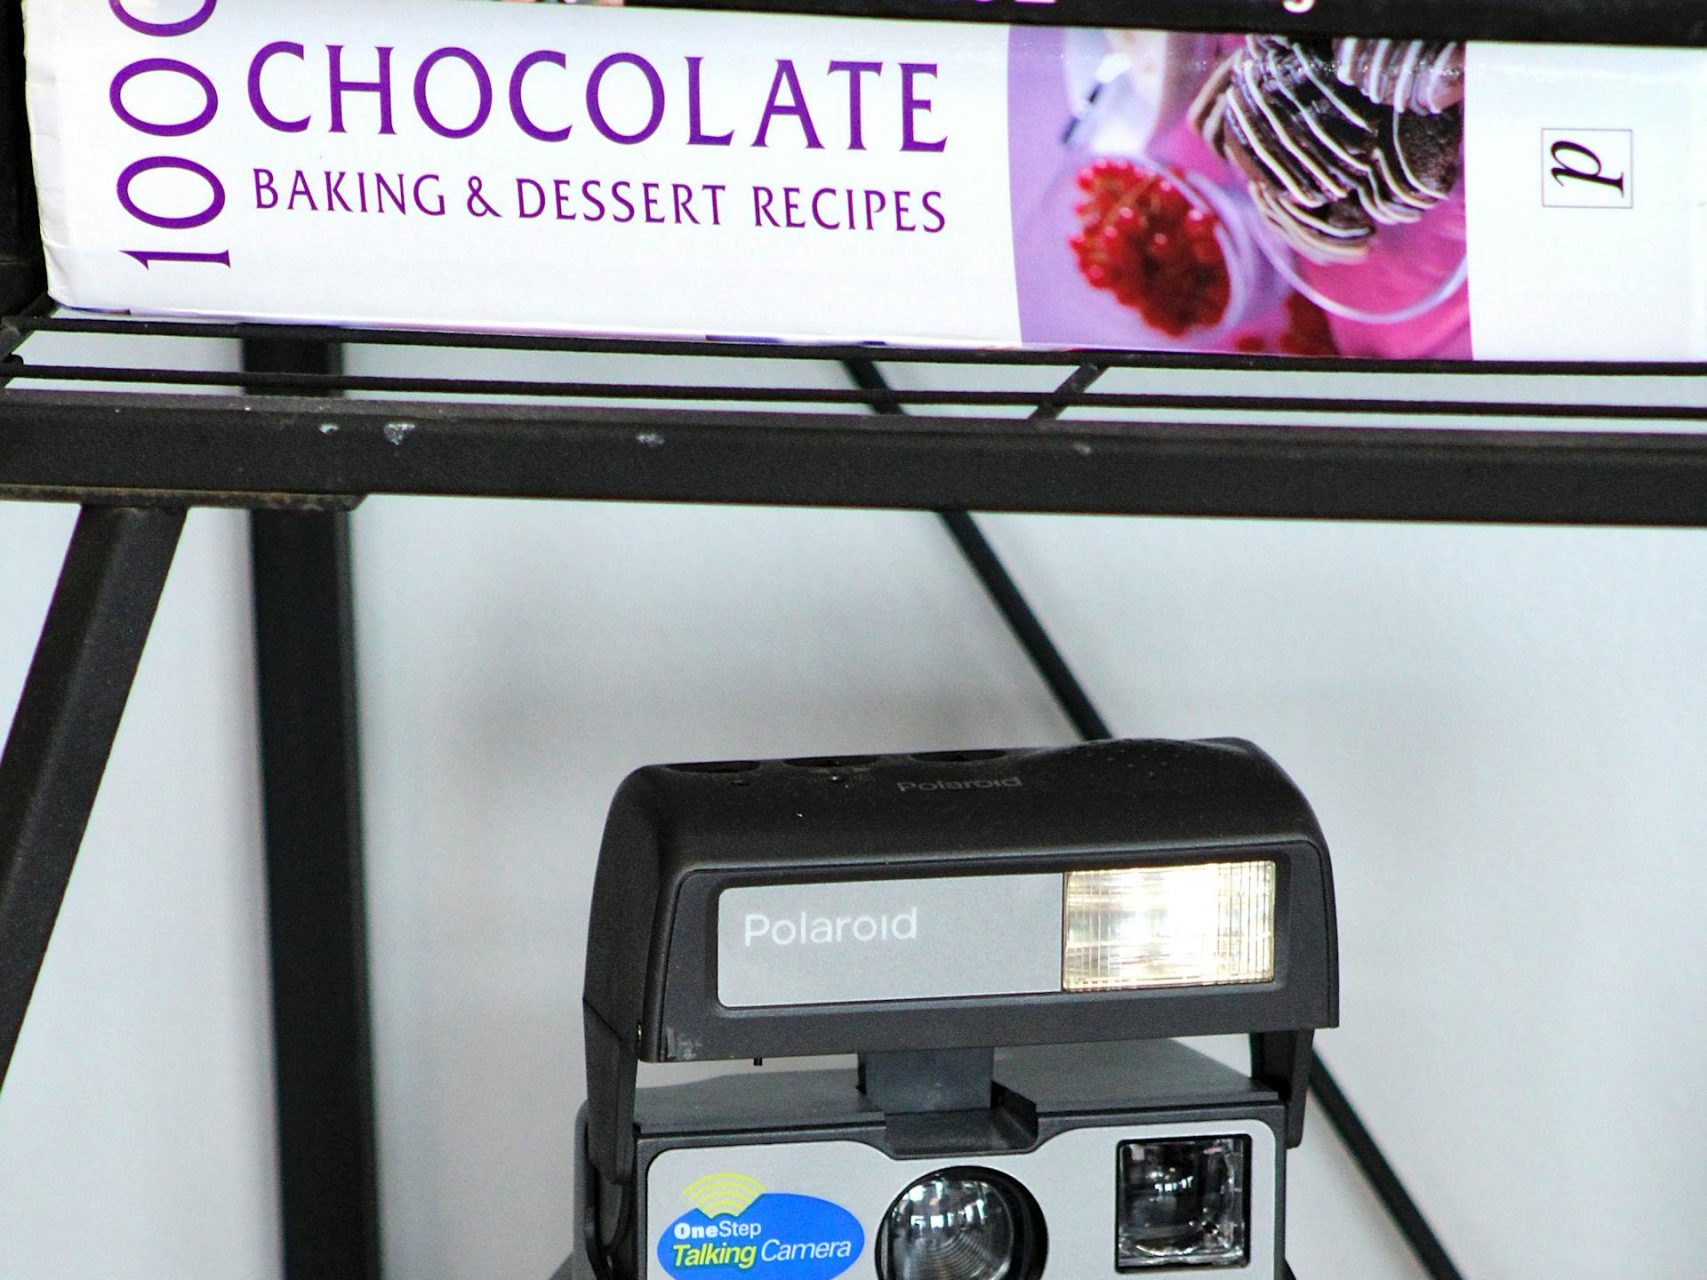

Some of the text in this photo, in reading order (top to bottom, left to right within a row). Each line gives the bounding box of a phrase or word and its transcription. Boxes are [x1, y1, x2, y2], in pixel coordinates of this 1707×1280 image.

[247, 40, 948, 153] CHOCOLATE
[254, 168, 947, 233] BAKING & DESSERT RECIPES
[897, 775, 1022, 793] Polaroid
[744, 906, 918, 947] Polaroid
[675, 1220, 762, 1241] OneStep
[672, 1238, 852, 1269] Talking Camera
